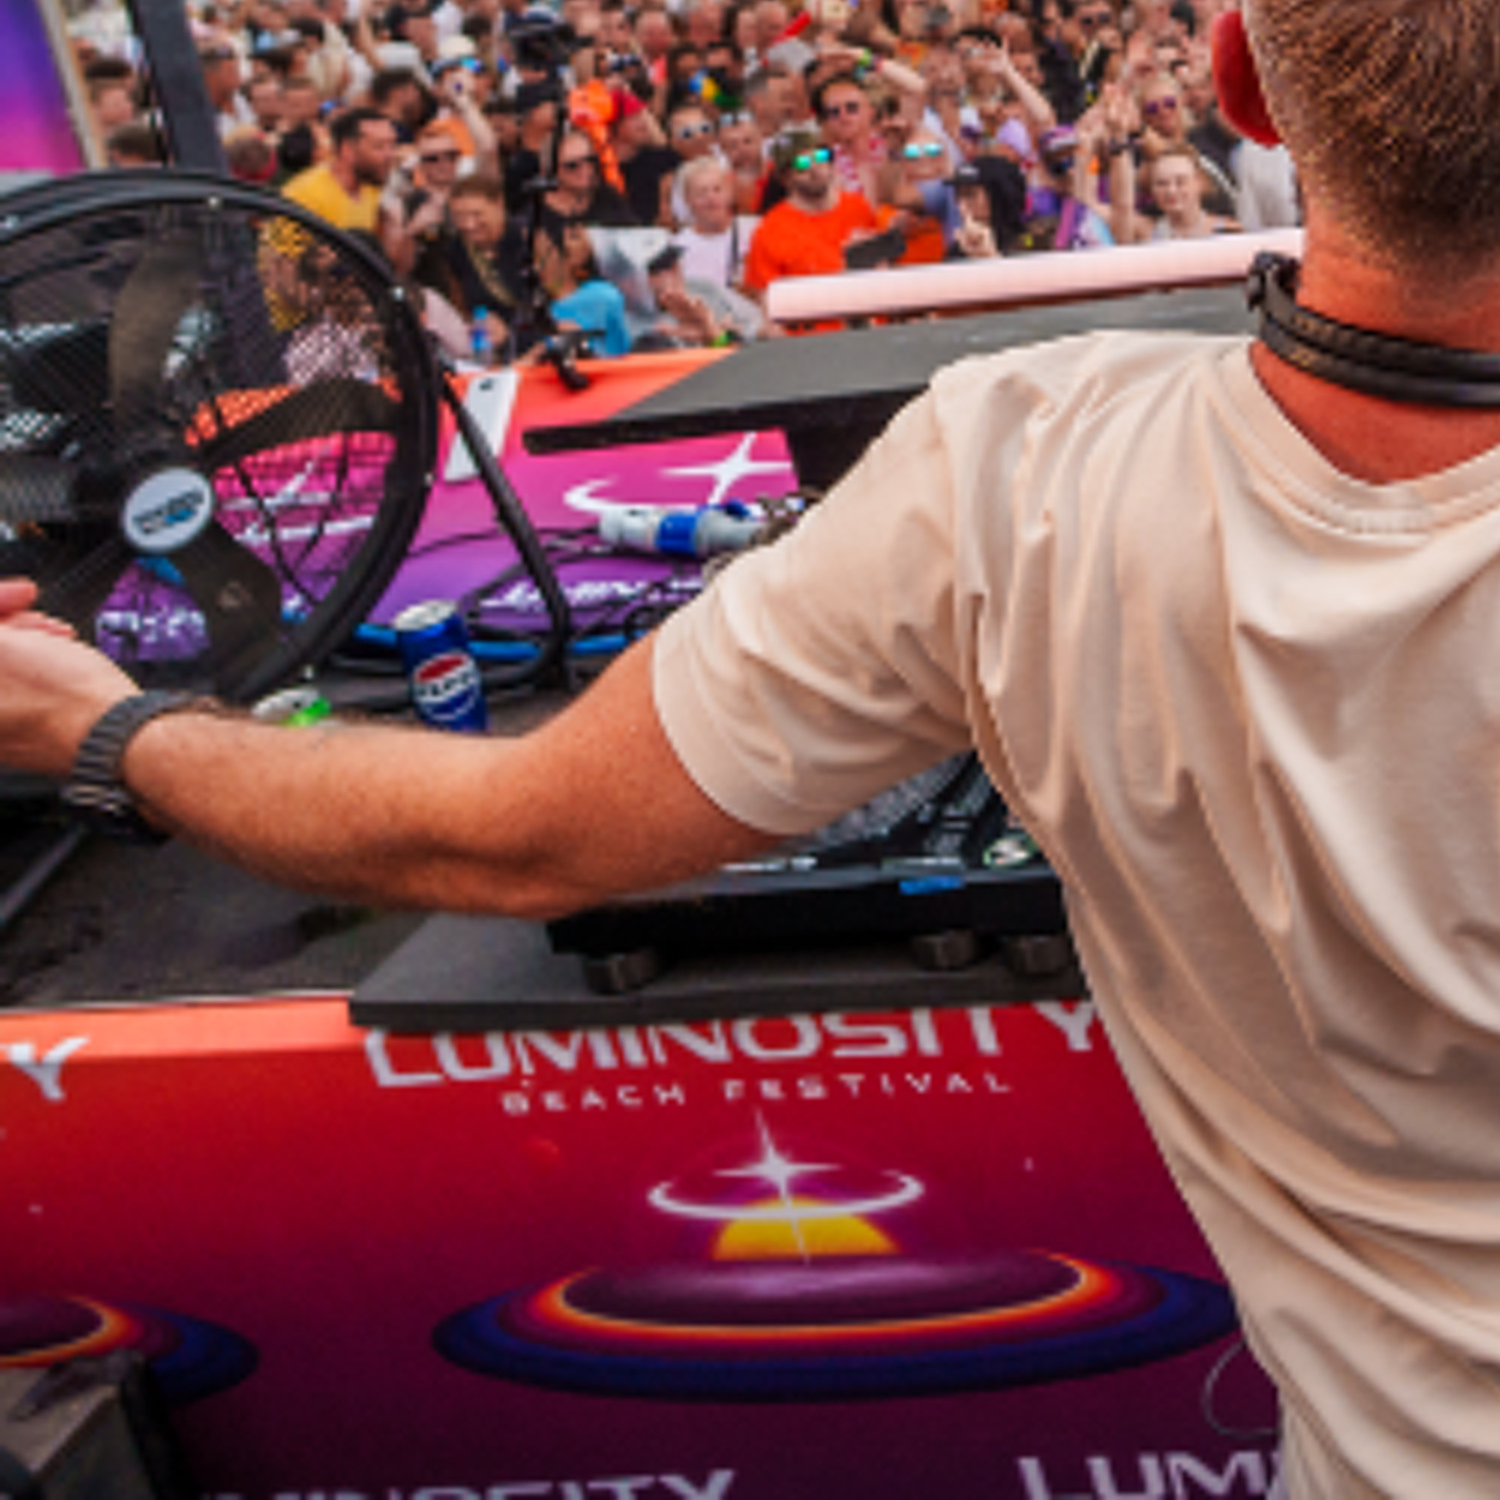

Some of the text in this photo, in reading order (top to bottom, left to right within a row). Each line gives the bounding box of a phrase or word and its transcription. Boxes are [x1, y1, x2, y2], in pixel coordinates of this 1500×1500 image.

[0, 1037, 90, 1102] Y
[502, 1071, 1012, 1116] BEACH FESTIVAL
[1016, 1450, 1284, 1500] LUM
